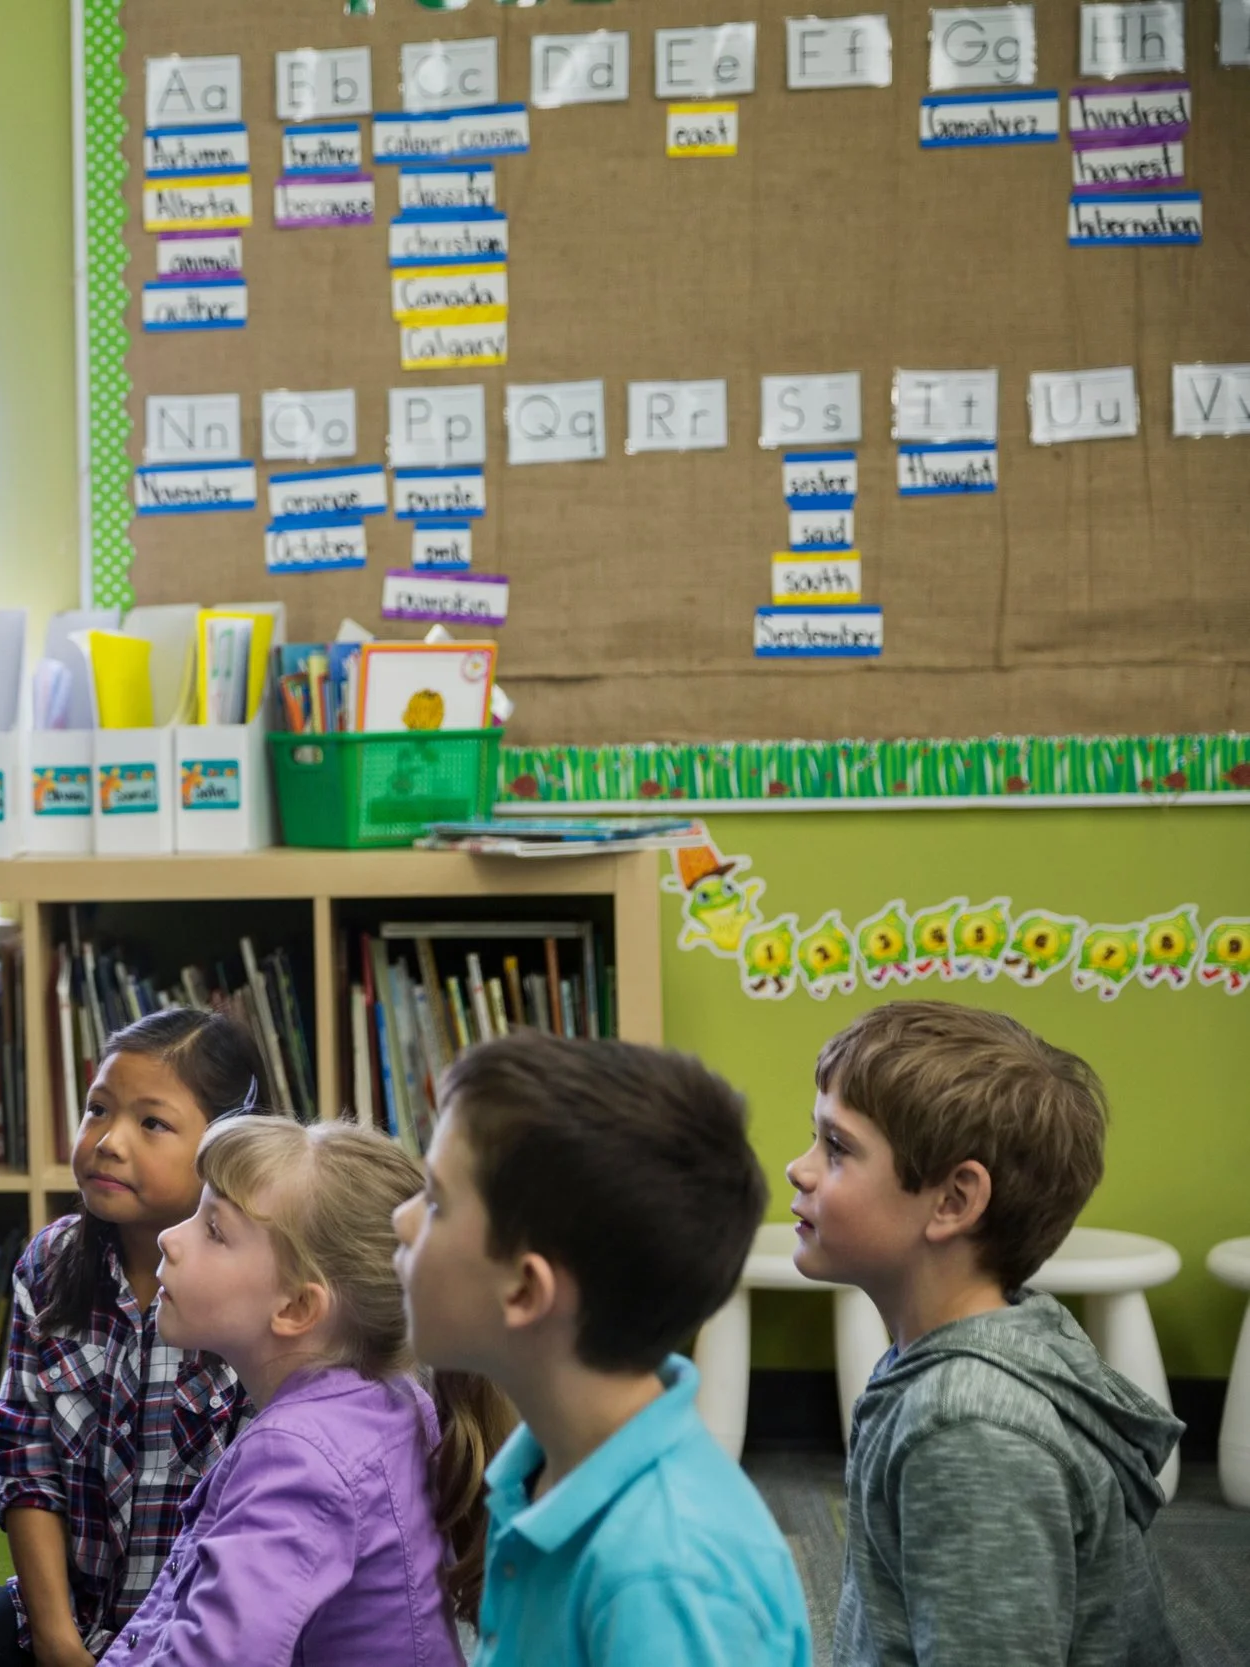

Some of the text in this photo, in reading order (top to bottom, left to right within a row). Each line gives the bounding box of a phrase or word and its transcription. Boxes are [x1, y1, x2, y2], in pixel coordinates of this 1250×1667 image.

[1079, 93, 1188, 129] hundred
[674, 115, 728, 147] east
[1077, 142, 1173, 182] harvest
[401, 278, 495, 310] Canada
